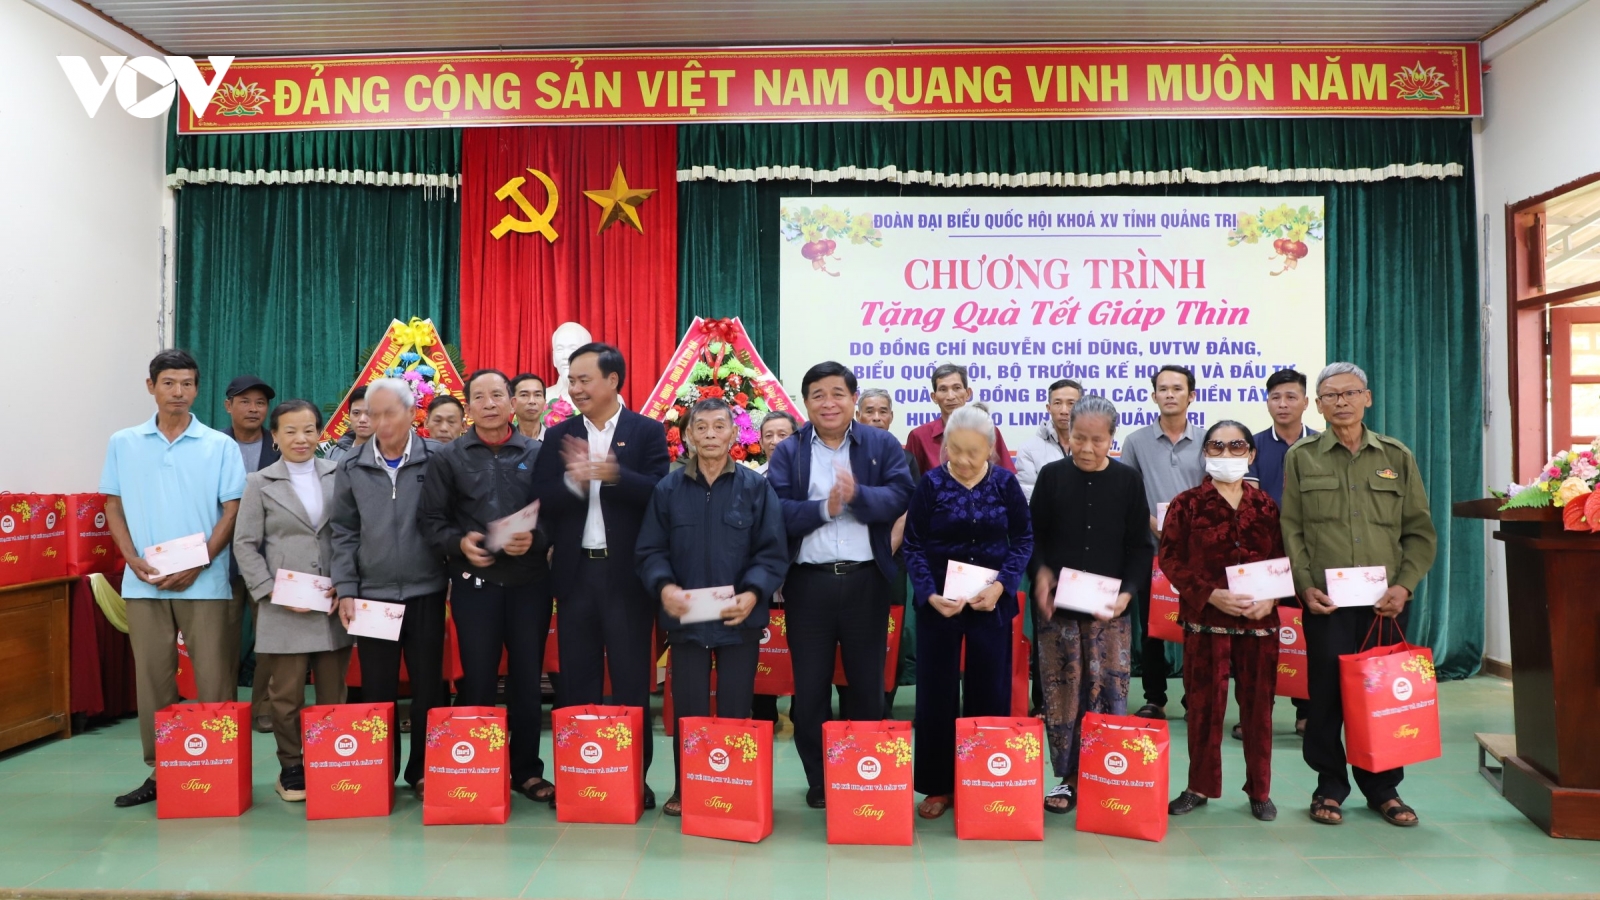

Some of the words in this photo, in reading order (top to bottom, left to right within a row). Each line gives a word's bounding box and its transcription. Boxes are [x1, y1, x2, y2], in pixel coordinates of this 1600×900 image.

[273, 64, 390, 116] ĐẢNG
[404, 64, 521, 119] CỘNG
[535, 57, 621, 110] SẢN
[637, 59, 736, 115] VIỆT
[754, 68, 849, 106] NAM
[864, 66, 1012, 111] QUANG
[1025, 64, 1128, 103] VINH
[1146, 53, 1274, 102] MUÔN
[1292, 55, 1388, 101] NĂM
[874, 210, 916, 229] ĐOÀN
[918, 213, 943, 231] ĐẠI
[948, 208, 980, 229] BIỂU
[985, 208, 1024, 230] QUỐC
[1028, 210, 1052, 231] HỘI
[1057, 210, 1096, 228] KHOÁ
[1100, 213, 1119, 228] XV
[1123, 209, 1156, 228] TỈNH
[1160, 209, 1210, 229] QUẢNG
[1214, 212, 1238, 231] TRỊ
[904, 253, 1070, 290] CHƯƠNG
[1083, 247, 1207, 290] TRÌNH
[861, 300, 946, 335] Tặng
[952, 299, 1021, 334] Quà
[1030, 296, 1082, 326] Tết
[1088, 299, 1166, 332] Giáp
[1176, 298, 1250, 326] Thìn
[850, 342, 874, 356] DO
[879, 338, 930, 356] ĐỒNG
[936, 339, 966, 356] CHÍ
[972, 337, 1046, 356] NGUYỄN
[1052, 339, 1082, 355] CHÍ
[1088, 339, 1143, 357] DŨNG,
[1149, 342, 1200, 356] UVTW
[1206, 337, 1262, 357] ĐẢNG,
[854, 360, 895, 379] BIỂU
[901, 361, 937, 381] QUỐ
[964, 362, 991, 382] ỘI,
[998, 363, 1021, 382] BỘ
[1028, 361, 1100, 379] TRƯỞNG
[1106, 361, 1129, 379] KẾ
[1202, 364, 1225, 379] VÀ
[1230, 360, 1267, 379] ĐẦU
[895, 386, 931, 404] QUÀ
[979, 384, 1030, 403] ĐỒNG
[1112, 385, 1148, 403] CÁC
[1237, 385, 1268, 402] TÂY
[1009, 412, 1050, 426] LINH
[1187, 411, 1205, 428] RỊ
[181, 779, 212, 793] Tặng
[331, 779, 362, 794] Tặng
[448, 786, 478, 802] Tặng
[578, 786, 608, 801] Tặng
[704, 796, 734, 812] Tặng
[853, 804, 885, 820] Tặng
[984, 800, 1016, 816] Tặng
[1100, 798, 1132, 815] Tặng
